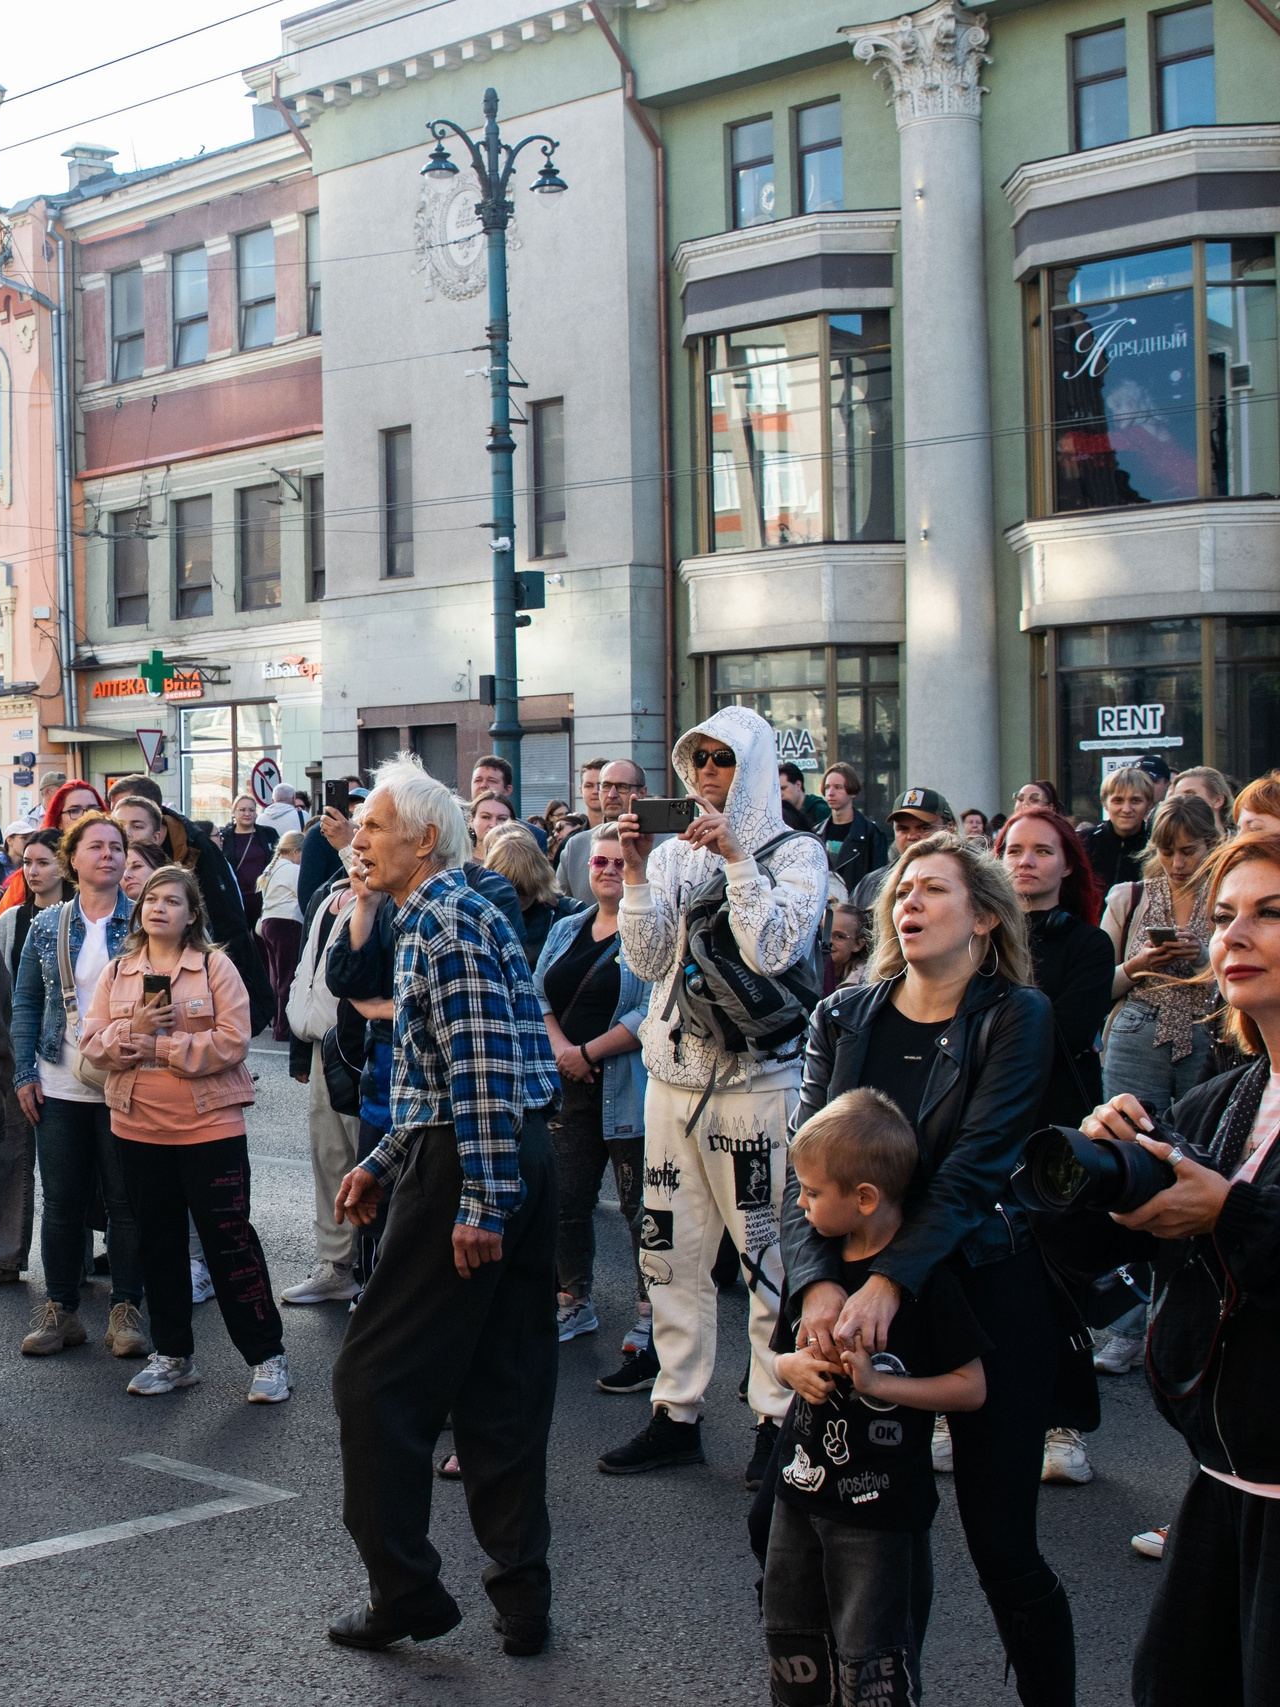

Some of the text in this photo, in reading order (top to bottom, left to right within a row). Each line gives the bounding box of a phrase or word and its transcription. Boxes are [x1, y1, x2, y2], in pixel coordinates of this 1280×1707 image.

[1062, 317, 1188, 380] Нарядный
[92, 676, 147, 698] АПТЕКА
[165, 690, 203, 699] ЭКСПРЕСС
[1101, 706, 1161, 732] RENT
[728, 960, 763, 1004] umbia
[874, 1425, 898, 1441] OK
[837, 1471, 891, 1501] positive
[851, 1490, 880, 1505] VIBES
[859, 1680, 894, 1698] OWN
